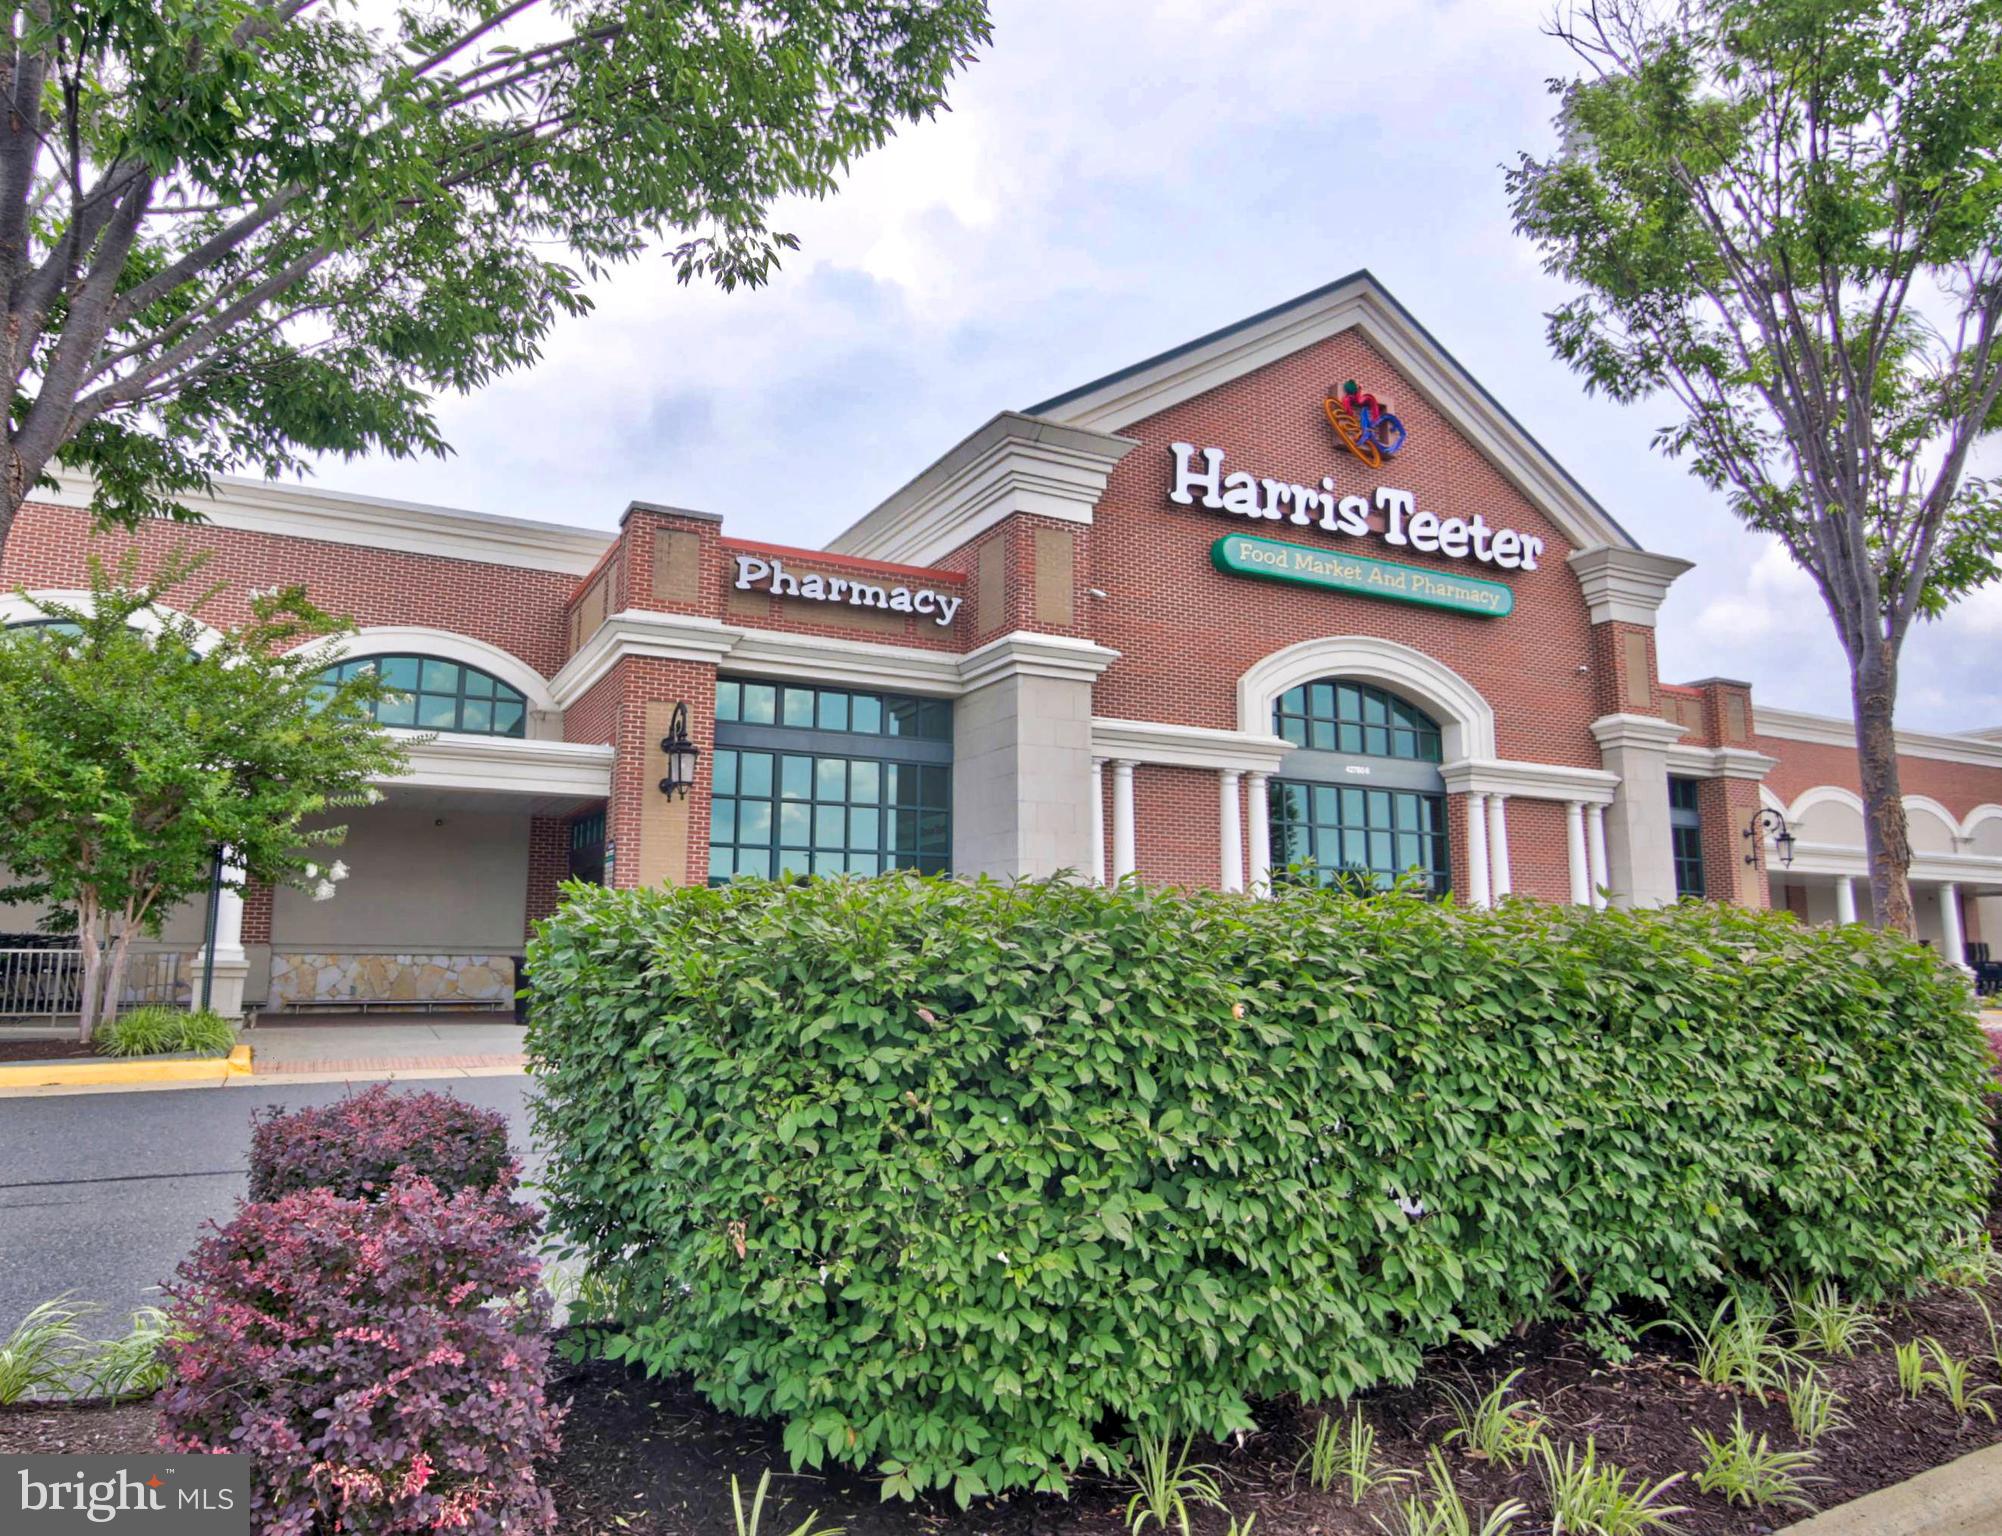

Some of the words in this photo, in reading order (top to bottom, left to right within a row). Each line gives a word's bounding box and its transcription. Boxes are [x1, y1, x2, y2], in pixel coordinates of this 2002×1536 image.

[1169, 441, 1370, 538] Harris
[1376, 486, 1543, 571] Teeter
[734, 555, 963, 626] Pharmacy
[1239, 542, 1289, 568] Food
[1294, 553, 1362, 581] Market
[1367, 566, 1407, 590] And
[1411, 573, 1501, 611] Pharmacy
